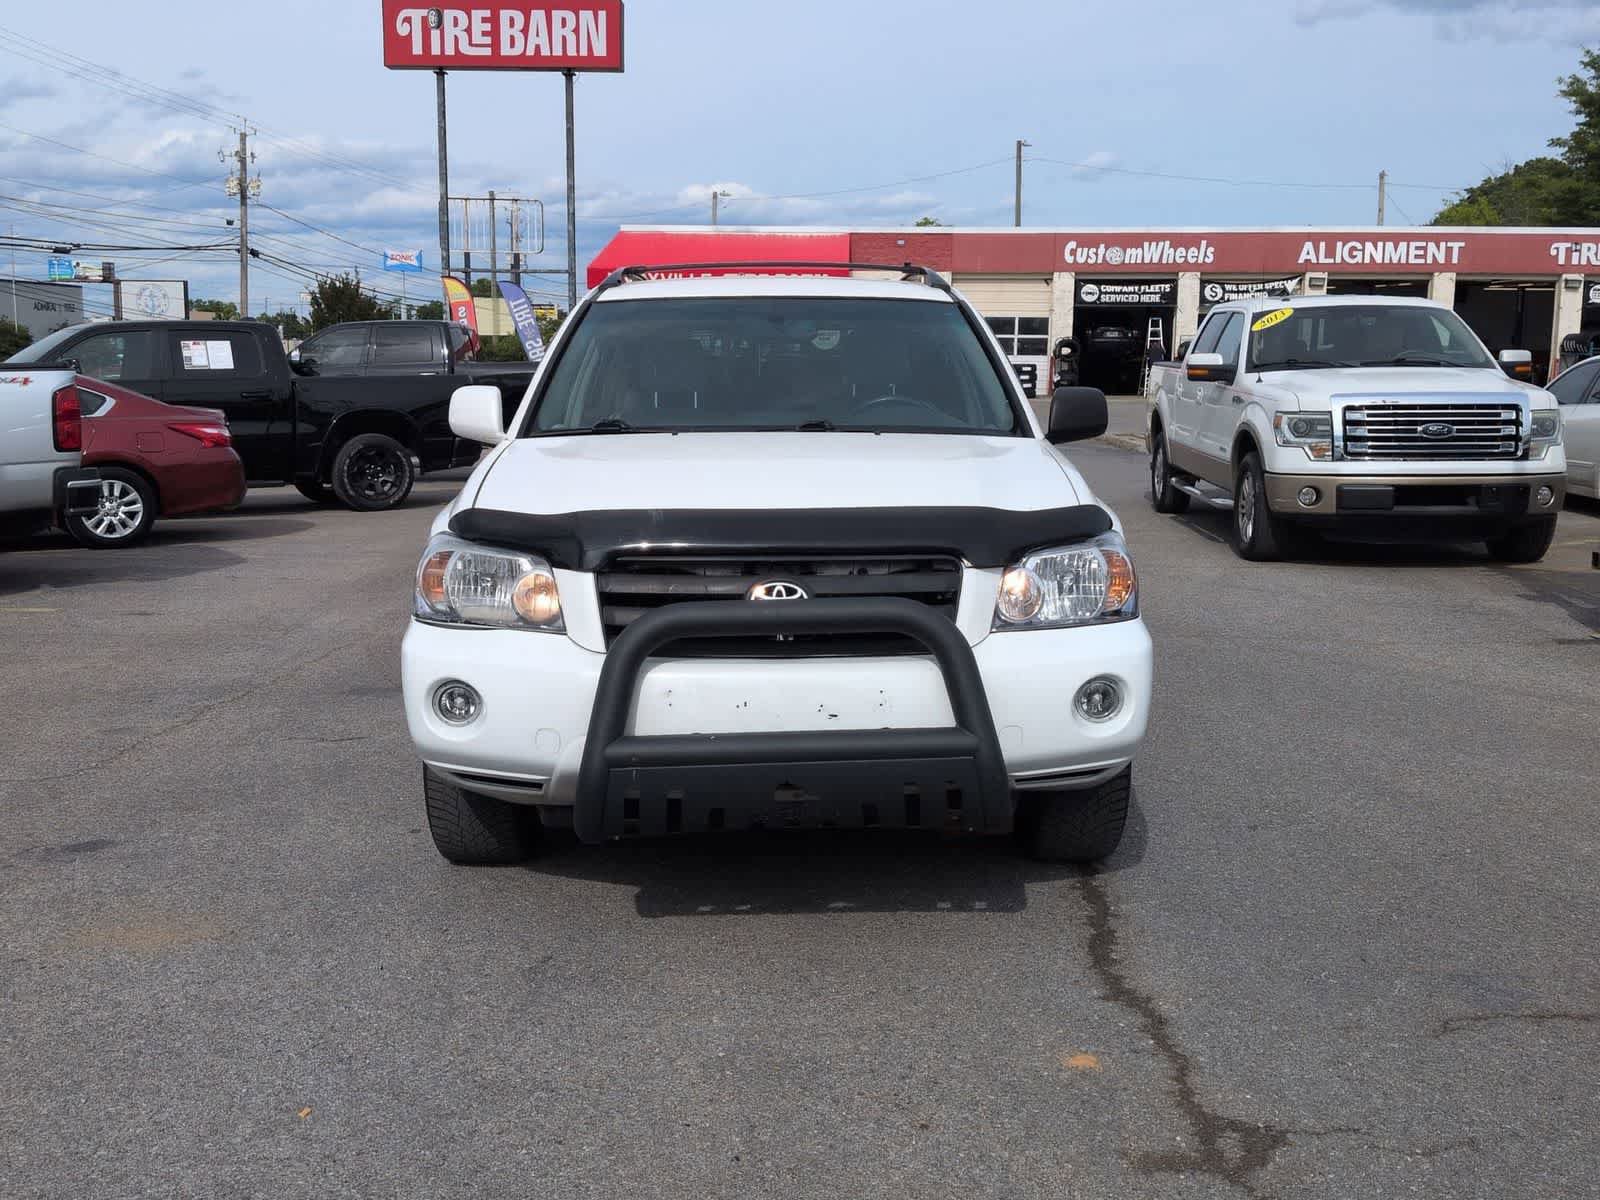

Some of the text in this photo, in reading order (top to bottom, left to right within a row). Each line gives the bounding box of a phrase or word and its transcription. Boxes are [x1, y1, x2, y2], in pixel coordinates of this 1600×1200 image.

[500, 9, 607, 57] BARN
[1298, 241, 1466, 264] ALIGNMENT
[1100, 284, 1171, 293] COMPANY FLEETS
[1224, 283, 1237, 291] WE
[1100, 294, 1139, 303] SERVICED
[1140, 294, 1161, 303] HERE
